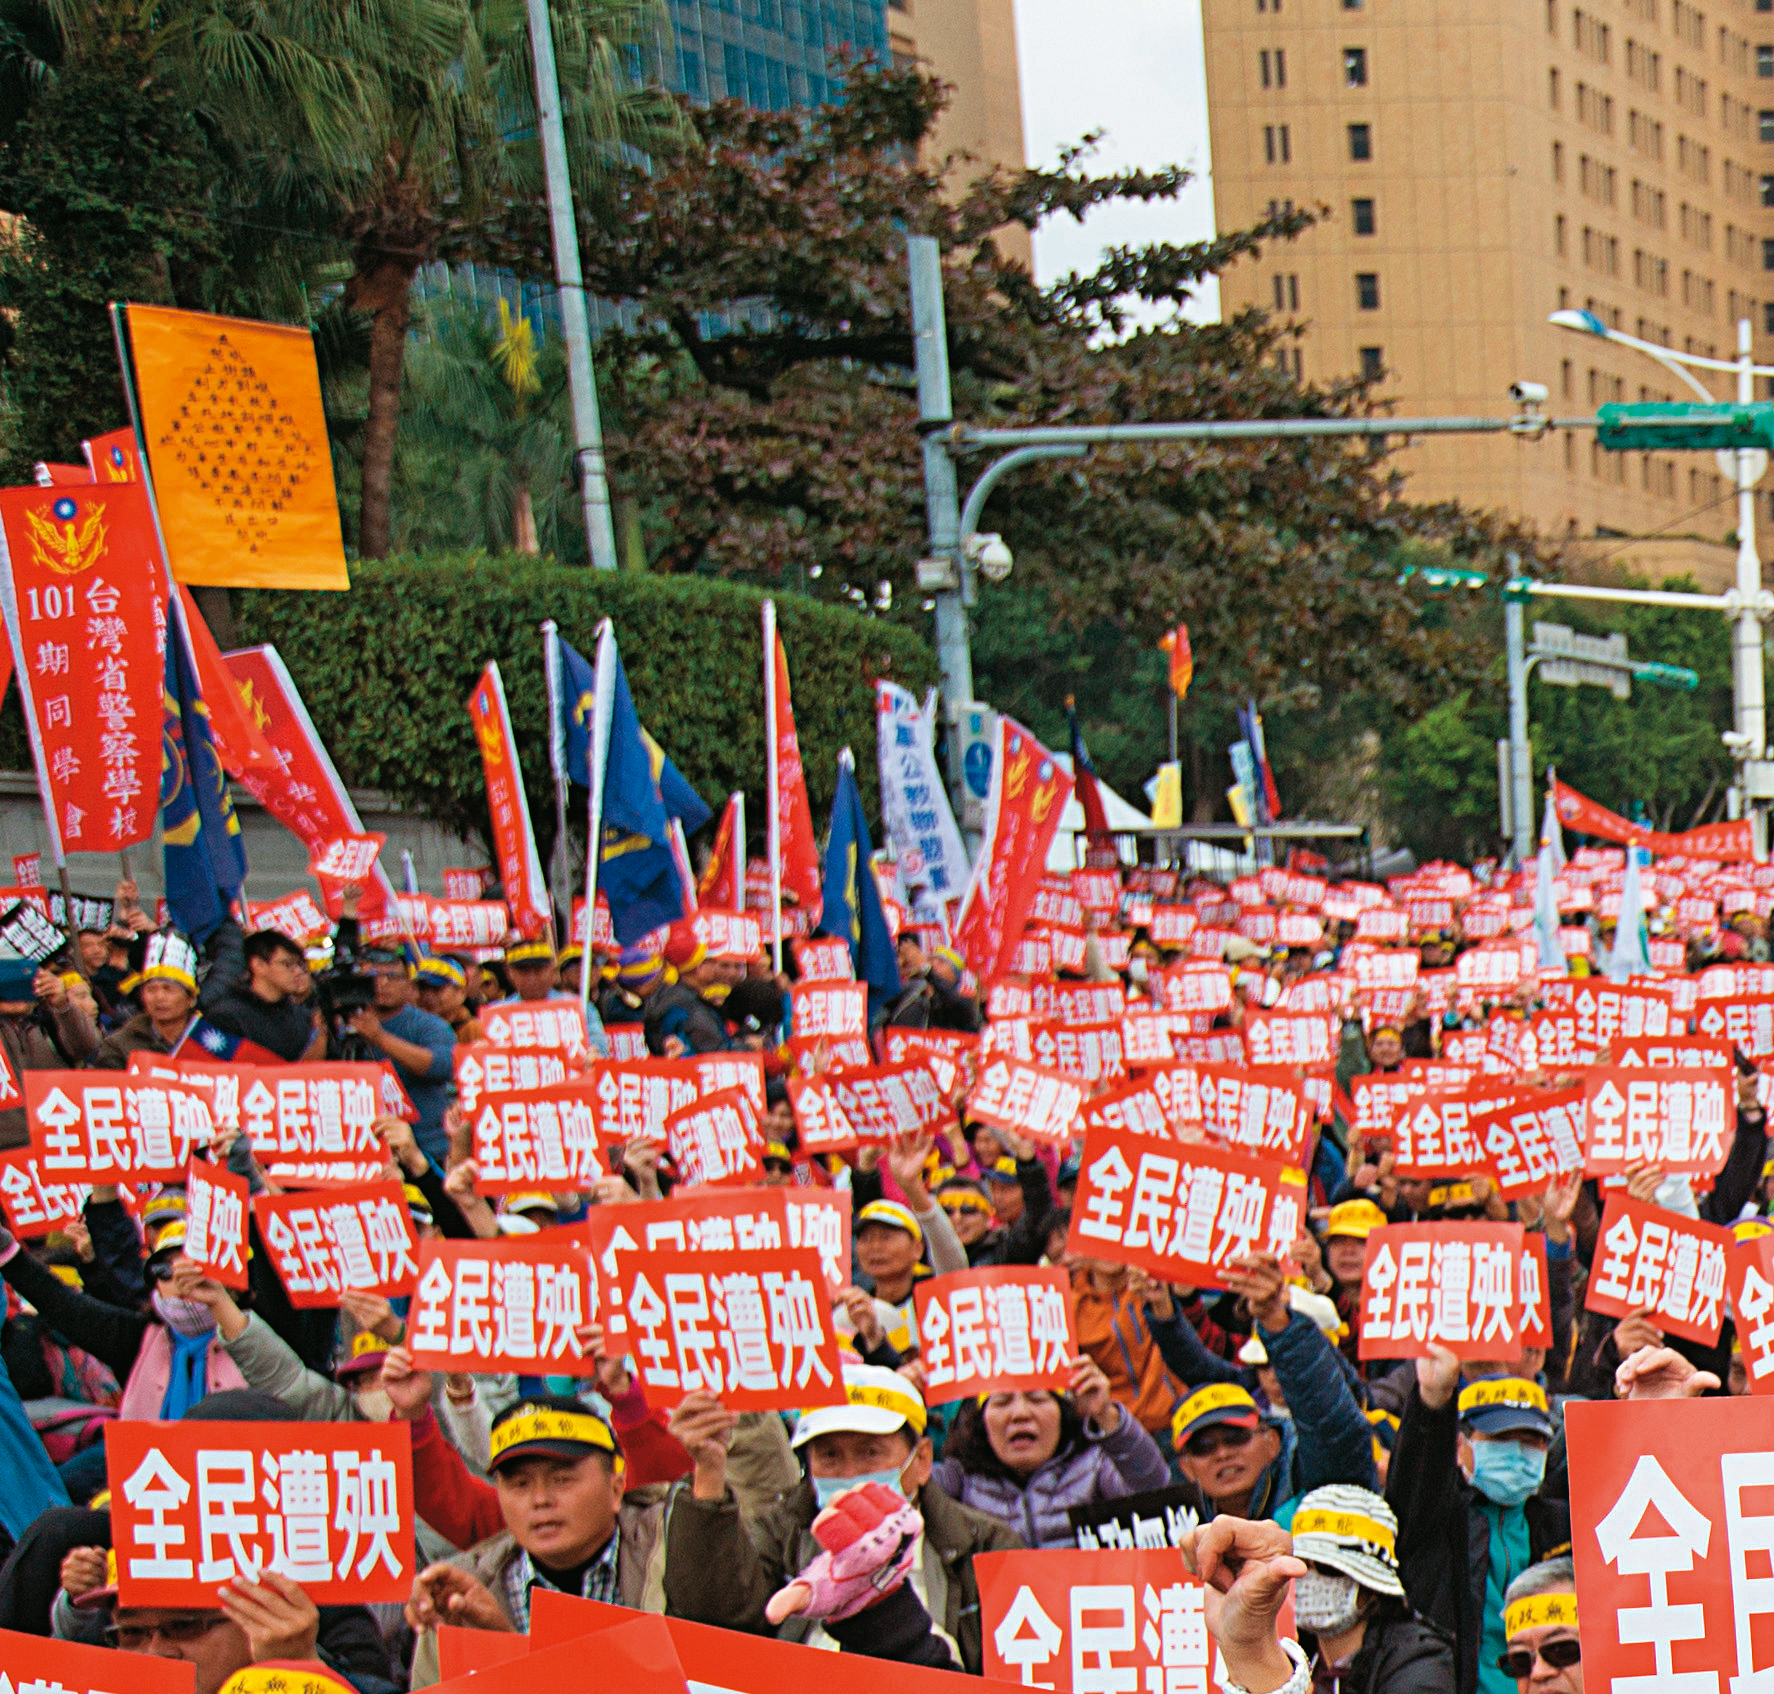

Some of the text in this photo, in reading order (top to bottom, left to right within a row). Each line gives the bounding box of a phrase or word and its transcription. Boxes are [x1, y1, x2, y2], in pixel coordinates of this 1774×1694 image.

[84, 578, 143, 842] 台灣省警察學校
[797, 987, 865, 1037] 全民遭殃
[1248, 1016, 1333, 1066] 全民遭殃
[1576, 988, 1670, 1042] 全民遭殃
[1035, 1029, 1124, 1081] 全民遭殃
[37, 1086, 214, 1171] 全民遭殃
[242, 1077, 378, 1153] 全民遭殃
[477, 1100, 600, 1182] 全民遭殃
[836, 1069, 951, 1135] 全民遭殃
[975, 1062, 1087, 1139] 全民遭殃
[1199, 1073, 1298, 1152] 全民遭殃
[1418, 1106, 1486, 1169] 全民
[1590, 1079, 1725, 1163] 全民遭殃
[267, 1194, 418, 1294] 全民遭殃
[1079, 1144, 1268, 1270] 全民遭殃
[413, 1257, 586, 1358] 全民遭殃
[1366, 1240, 1513, 1343] 全民遭殃
[1597, 1214, 1726, 1331] 全民遭殃
[625, 1267, 835, 1394] 全民遭殃
[921, 1284, 1071, 1390] 全民遭殃
[123, 1448, 403, 1586] 全民遭殃
